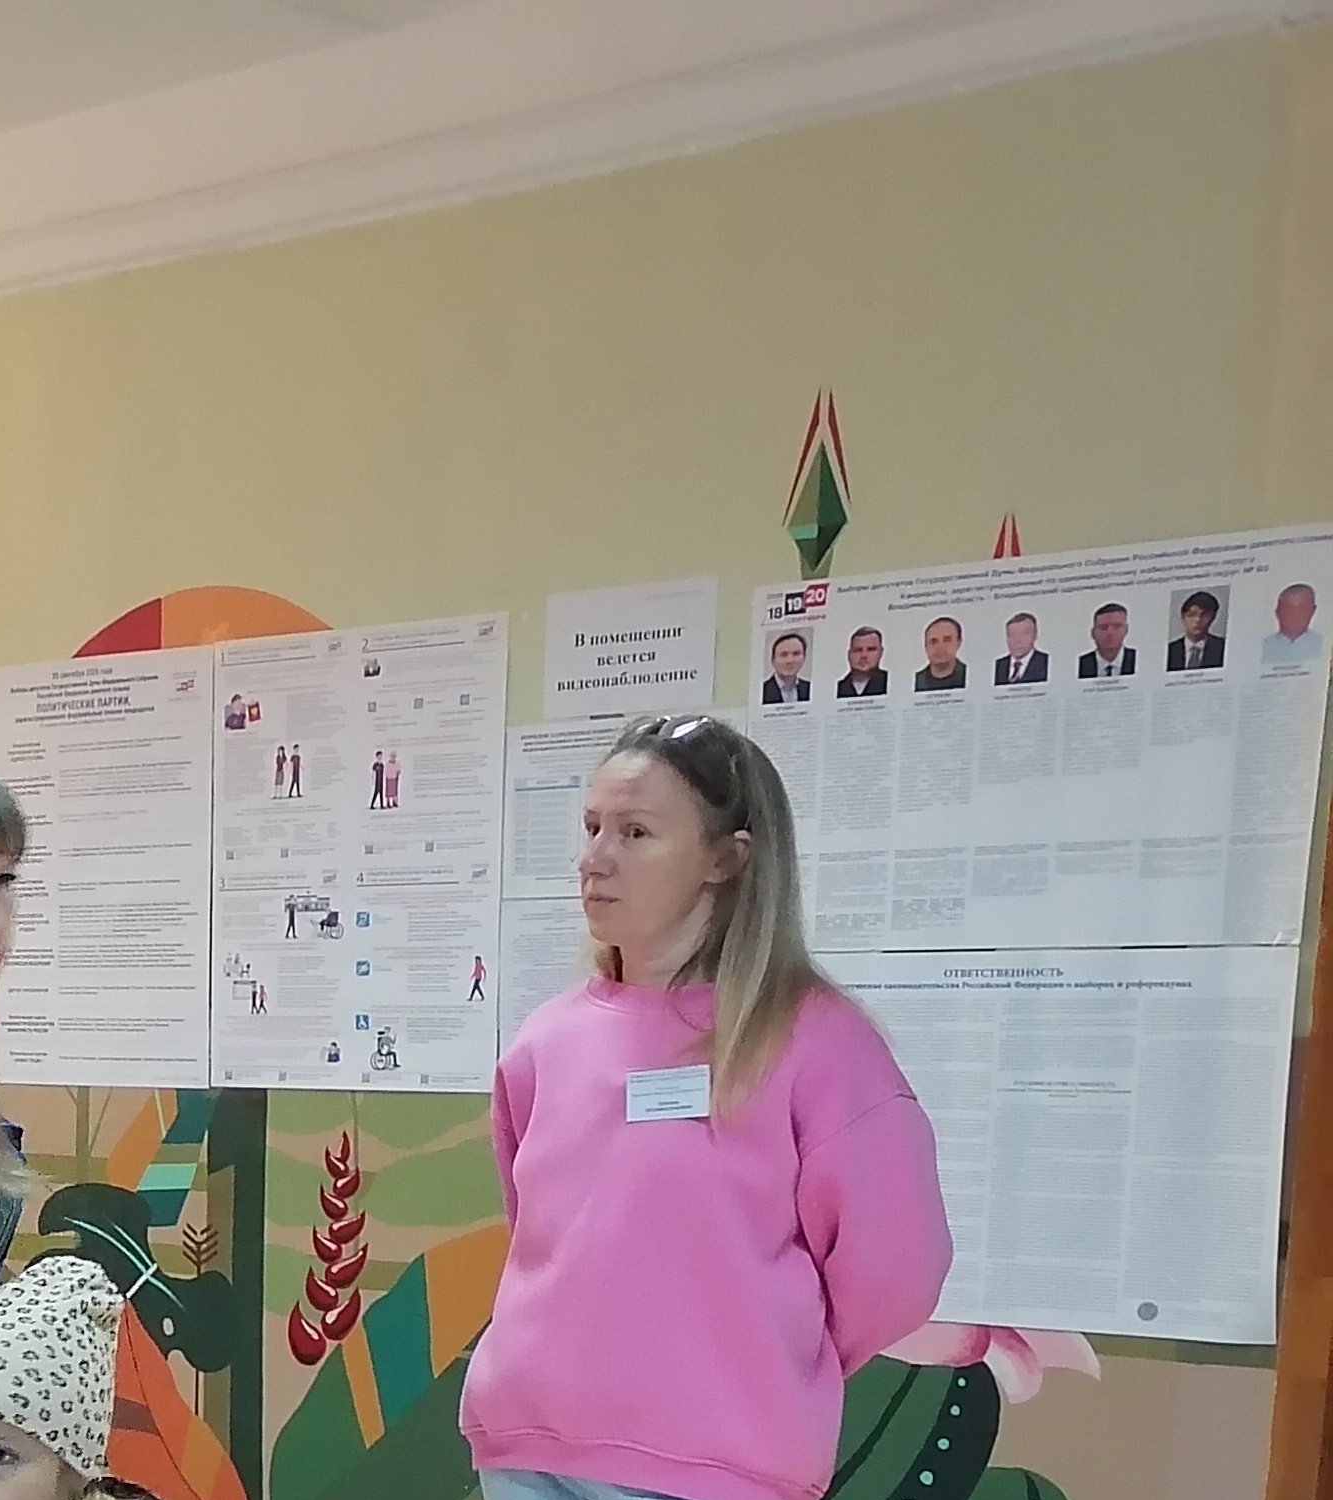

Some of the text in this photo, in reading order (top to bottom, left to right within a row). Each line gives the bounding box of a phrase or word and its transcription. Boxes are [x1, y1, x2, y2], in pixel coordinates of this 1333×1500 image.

[768, 588, 826, 620] 18 19 20
[574, 626, 683, 648] В помещении
[362, 638, 370, 652] 2
[597, 650, 656, 667] ведется
[557, 668, 698, 692] видеонаблюдение
[219, 877, 226, 889] 3
[356, 872, 365, 884] 4
[943, 967, 1064, 979] ОТВЕТСТВЕННОСТЬ
